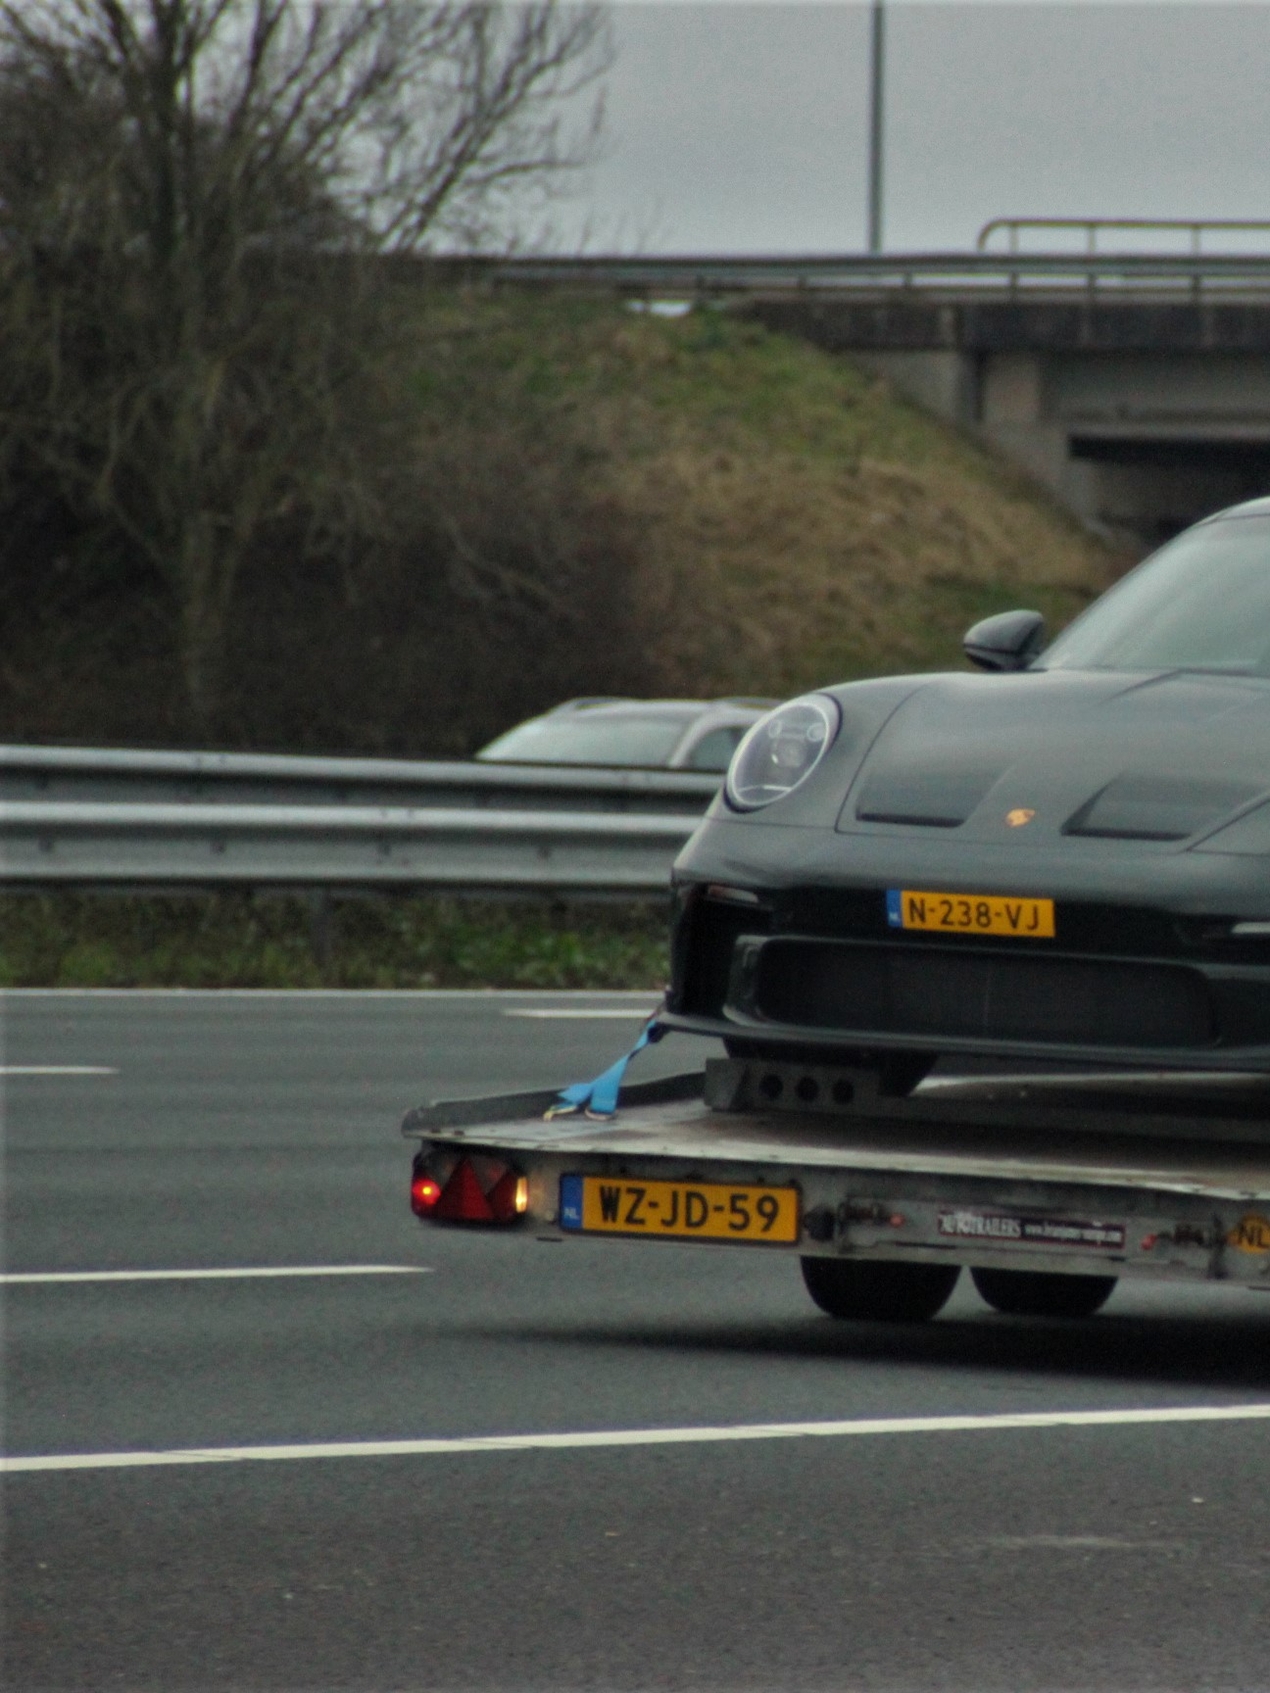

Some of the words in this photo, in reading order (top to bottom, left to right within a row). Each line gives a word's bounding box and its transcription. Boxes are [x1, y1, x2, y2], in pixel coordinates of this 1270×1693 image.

[909, 898, 1040, 931] N-238-VJ
[599, 1186, 780, 1232] WZ-JD-59
[1239, 1223, 1270, 1250] NL
